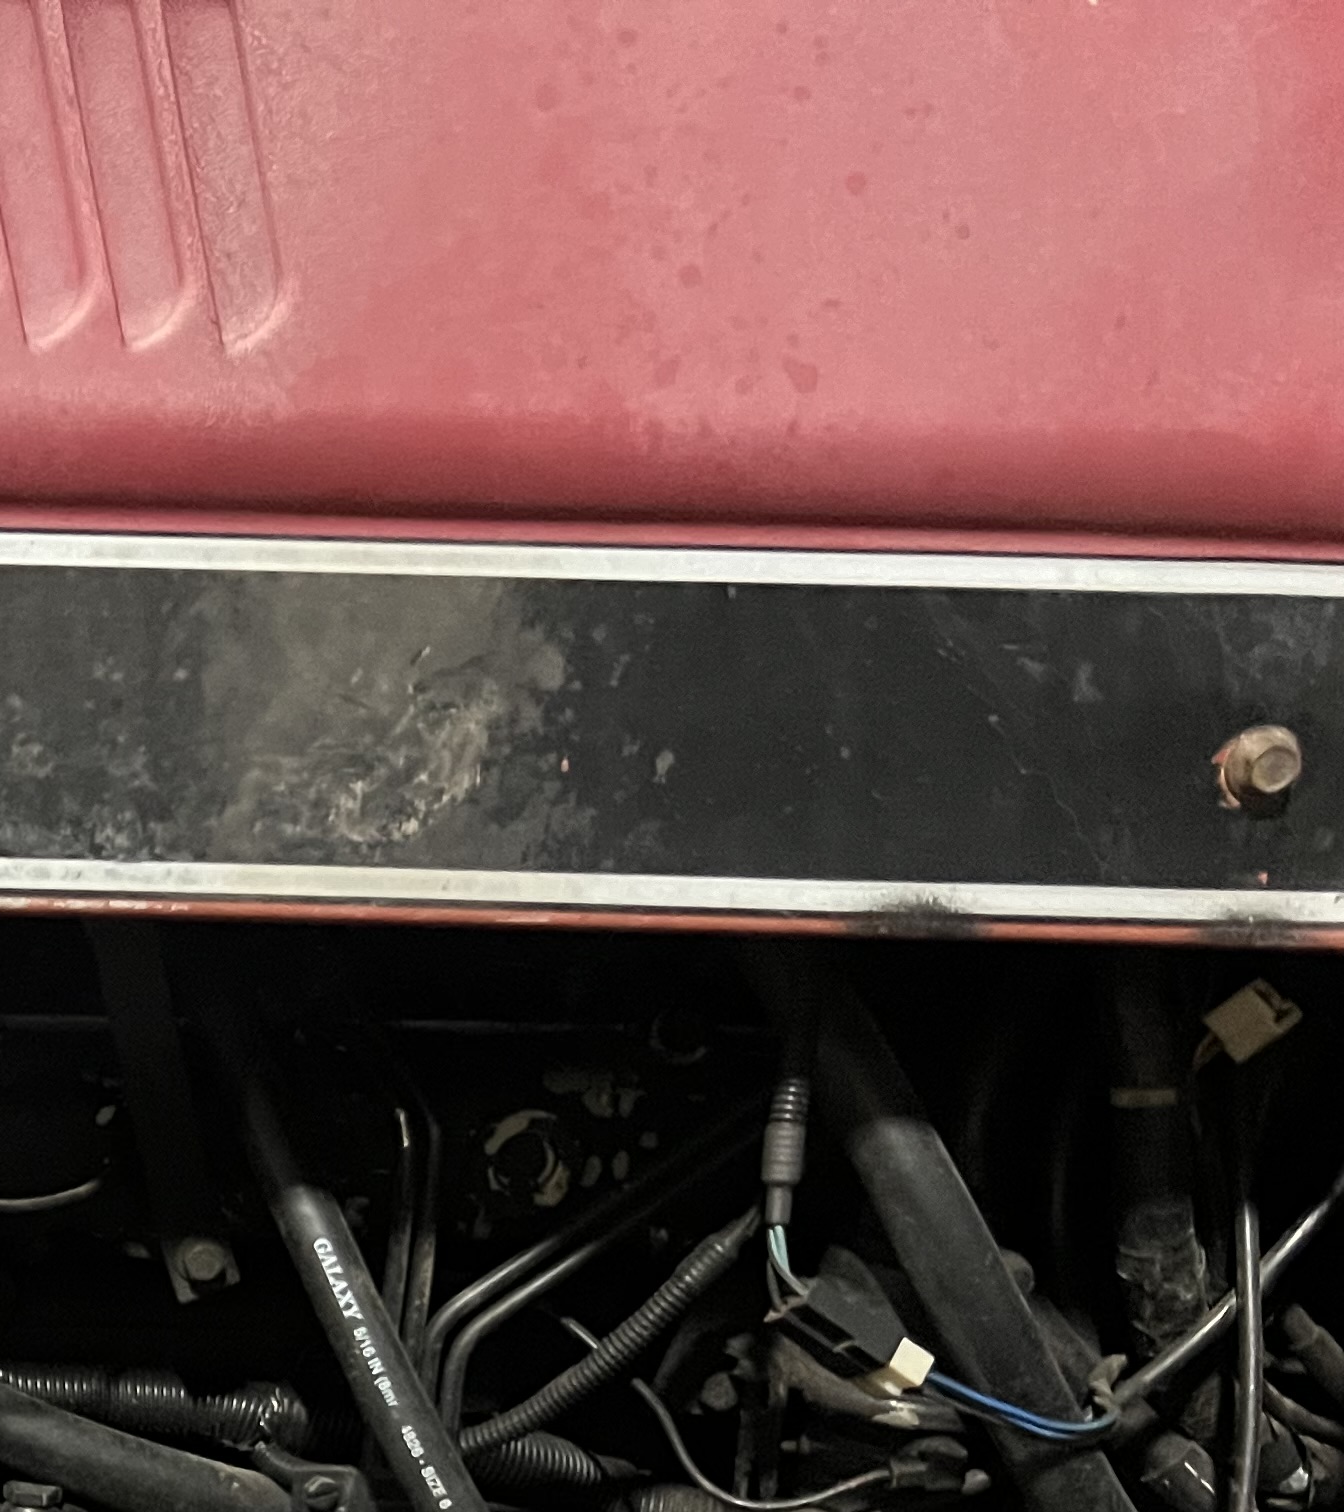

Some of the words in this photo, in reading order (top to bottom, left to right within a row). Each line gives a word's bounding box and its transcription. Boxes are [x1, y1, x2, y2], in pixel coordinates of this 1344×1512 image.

[313, 1237, 365, 1319] GALAXY
[368, 1356, 386, 1375] IN
[421, 1465, 448, 1498] SIZE
